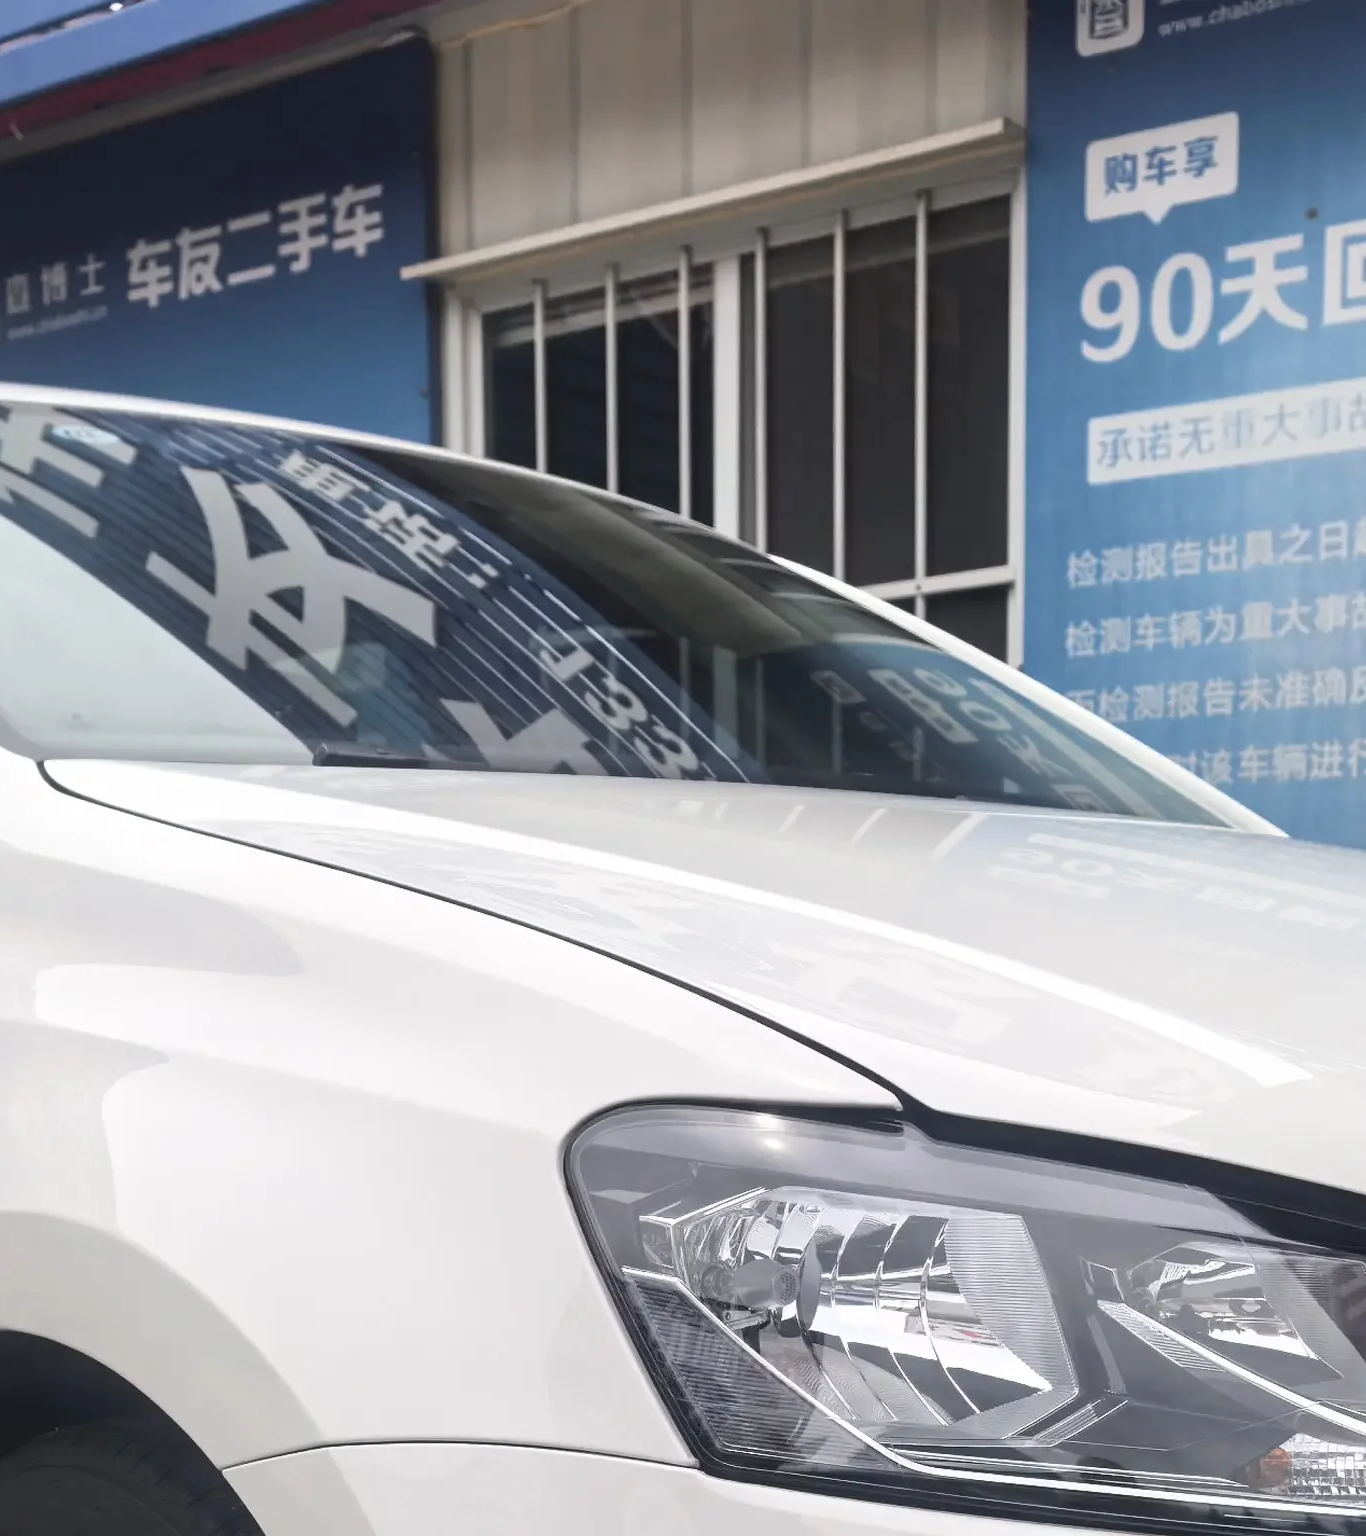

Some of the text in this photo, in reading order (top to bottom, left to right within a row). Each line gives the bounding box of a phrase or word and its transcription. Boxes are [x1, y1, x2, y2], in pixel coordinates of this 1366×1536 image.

[1103, 135, 1220, 196] 购车享
[125, 183, 384, 308] 车友二手车
